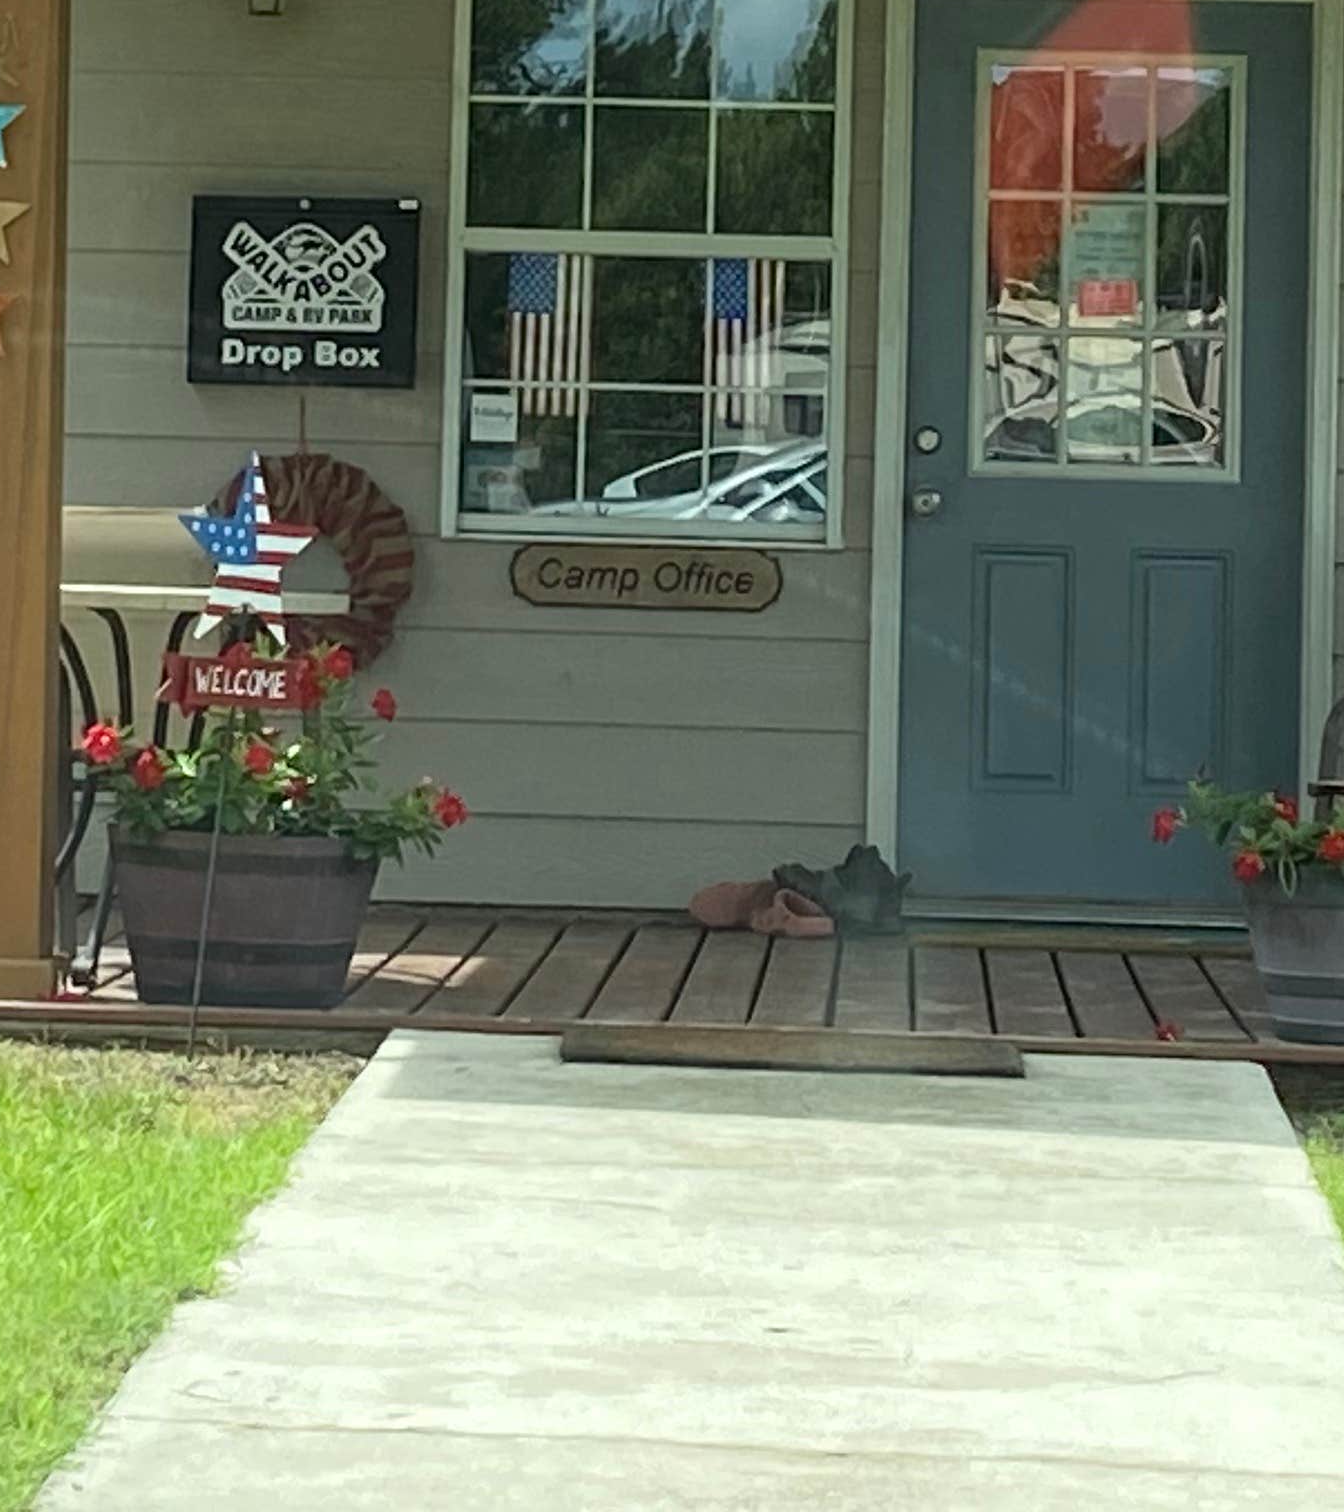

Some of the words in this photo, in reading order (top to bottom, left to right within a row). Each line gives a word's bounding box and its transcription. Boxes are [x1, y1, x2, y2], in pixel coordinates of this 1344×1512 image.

[230, 230, 379, 301] WALKABOUT
[232, 306, 282, 322] CAMP
[286, 307, 297, 323] &
[303, 307, 324, 324] RV
[329, 308, 373, 324] PARK
[221, 338, 303, 371] Drop
[314, 340, 380, 367] Box
[537, 557, 640, 598] Camp
[653, 561, 754, 596] Office
[195, 665, 287, 699] WELCOME
